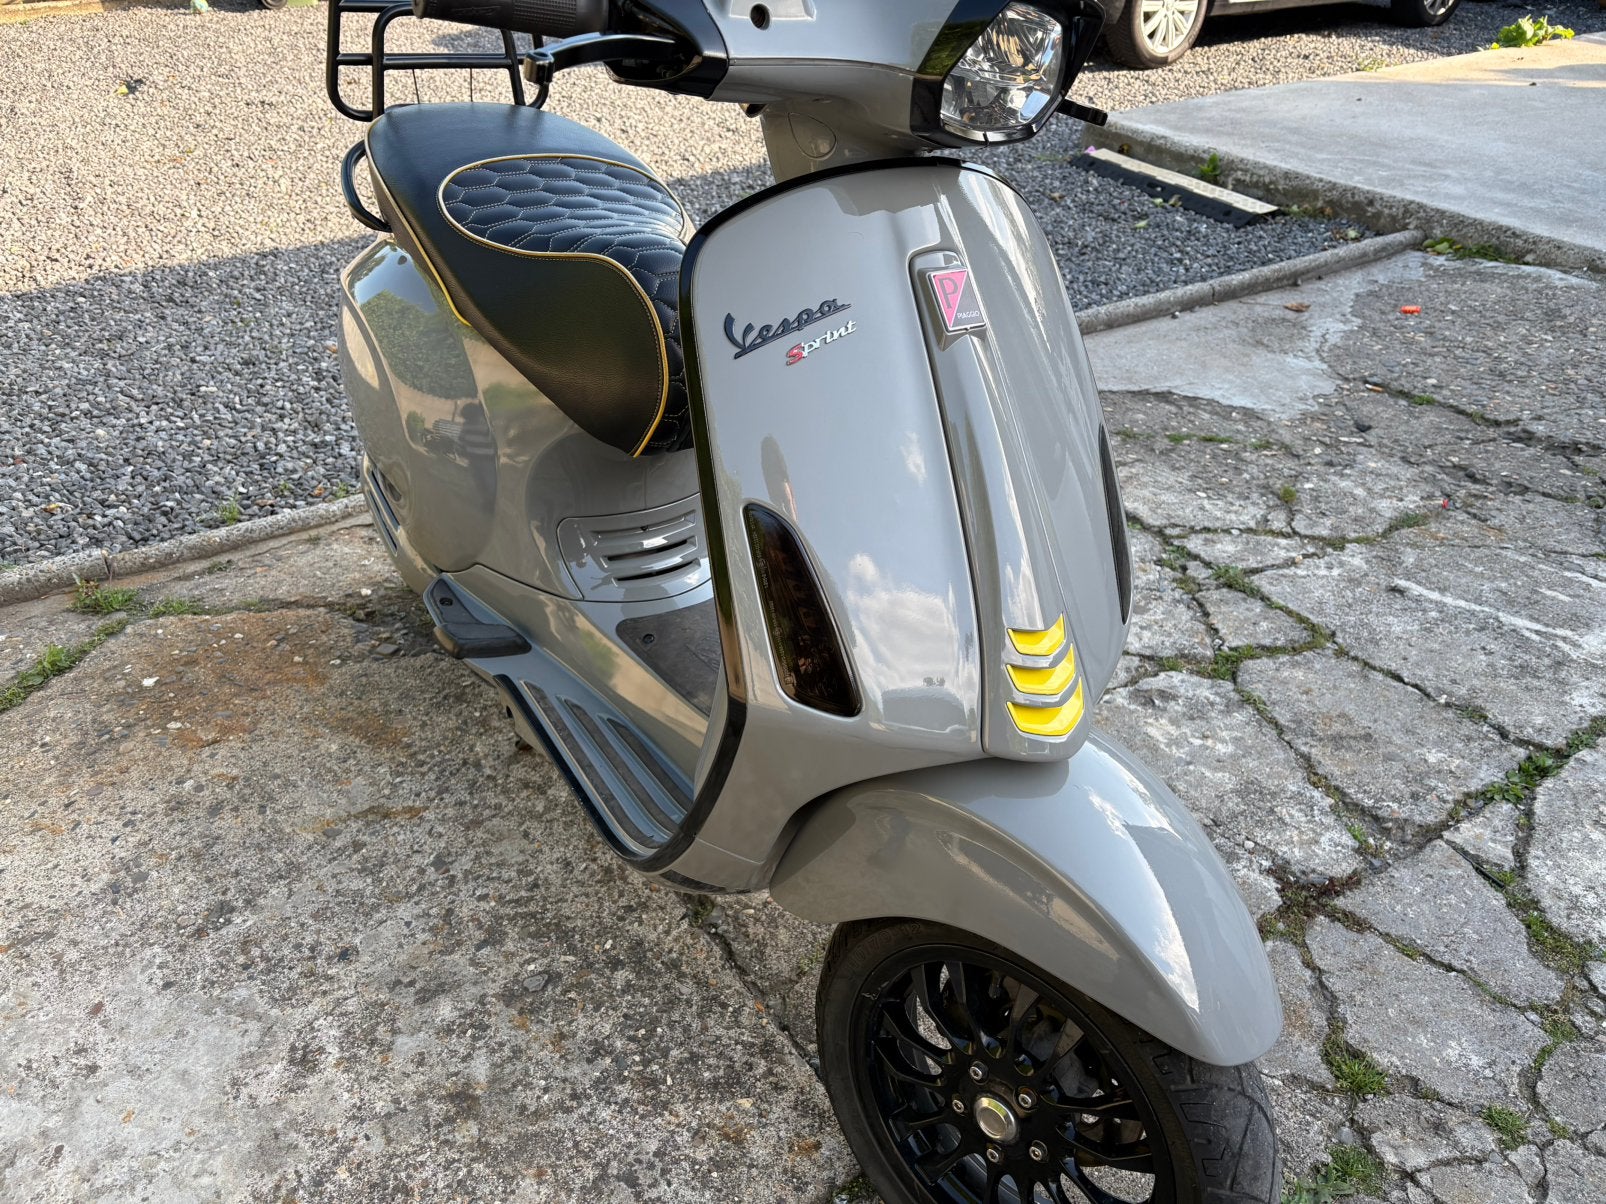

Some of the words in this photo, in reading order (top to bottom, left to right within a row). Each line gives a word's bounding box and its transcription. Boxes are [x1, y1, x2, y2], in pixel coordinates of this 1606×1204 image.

[938, 277, 959, 309] P
[724, 298, 851, 359] Vespa
[956, 310, 980, 319] PIAGGIO
[786, 320, 857, 365] Sprint
